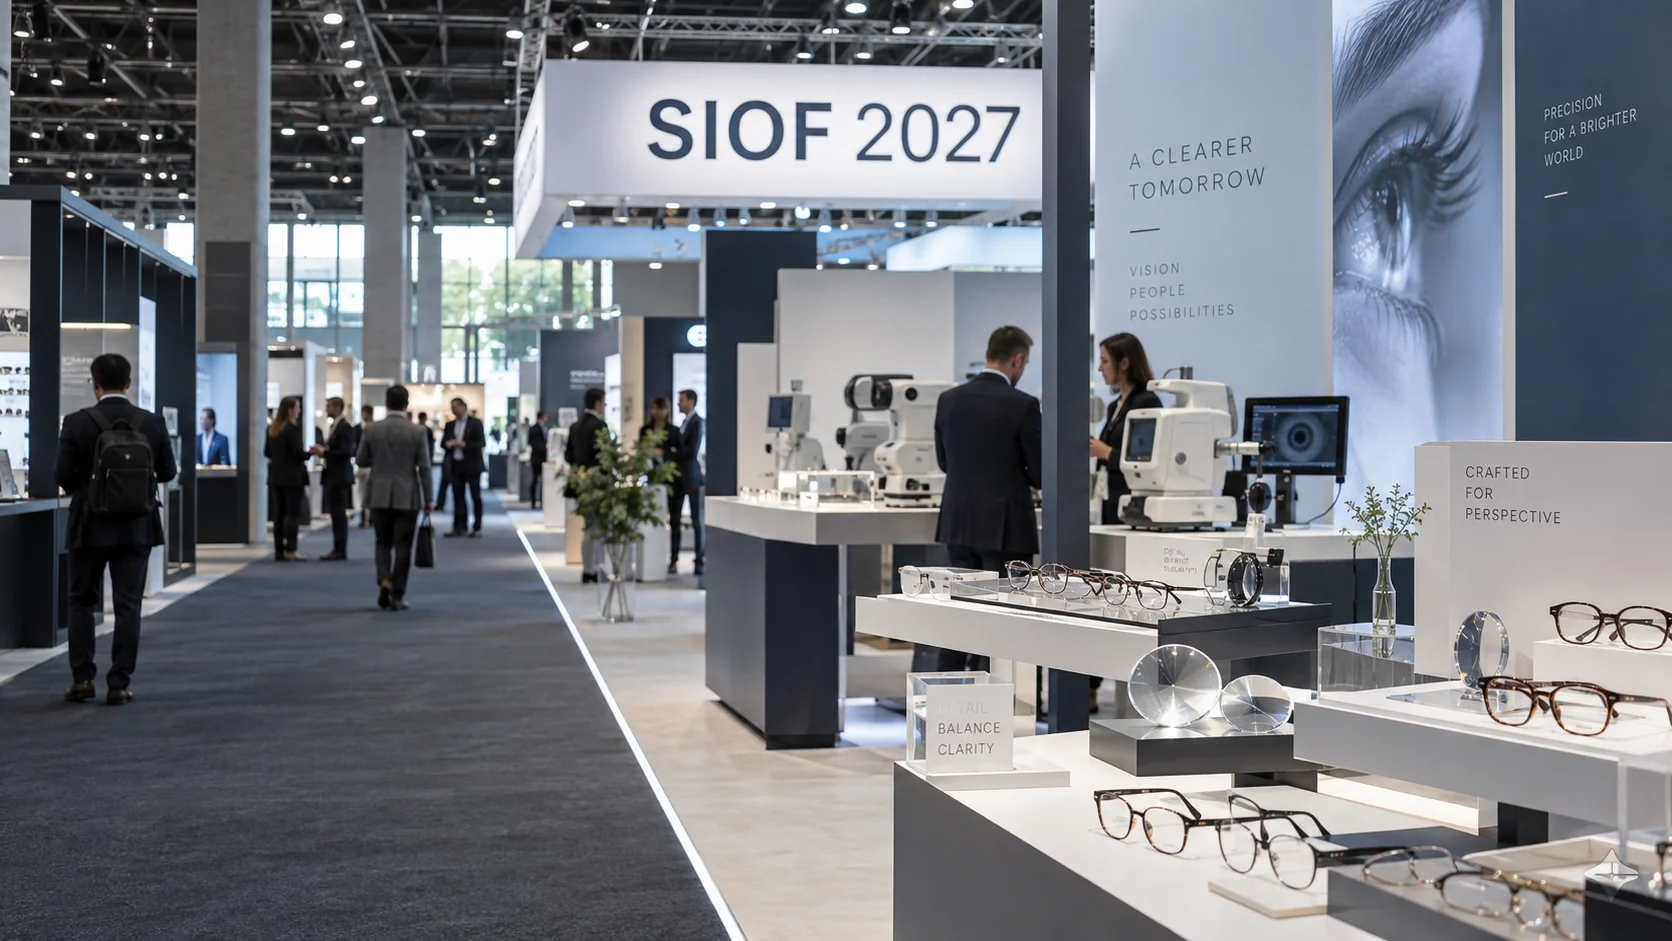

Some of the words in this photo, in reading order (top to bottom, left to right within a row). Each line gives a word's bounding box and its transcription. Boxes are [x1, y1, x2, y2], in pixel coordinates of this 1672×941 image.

[1544, 93, 1602, 121] PRECISION
[647, 98, 832, 160] SIOF
[856, 102, 1021, 163] 2027
[1544, 127, 1566, 144] FOR
[1569, 125, 1577, 138] A
[1580, 108, 1637, 135] BRIGHTER
[1129, 153, 1141, 170] A
[1152, 135, 1252, 166] CLEARER
[1544, 146, 1584, 167] WORLD
[1129, 166, 1265, 200] TOMORROW
[1129, 262, 1180, 277] VISION
[1130, 284, 1185, 299] PEOPLE
[1130, 303, 1234, 321] POSSIBILITIES
[1465, 465, 1530, 480] CRAFTED
[1465, 486, 1493, 500] FOR
[1465, 507, 1561, 524] PERSPECTIVE
[938, 721, 1000, 735] BALANCE
[937, 742, 995, 756] CLARITY
